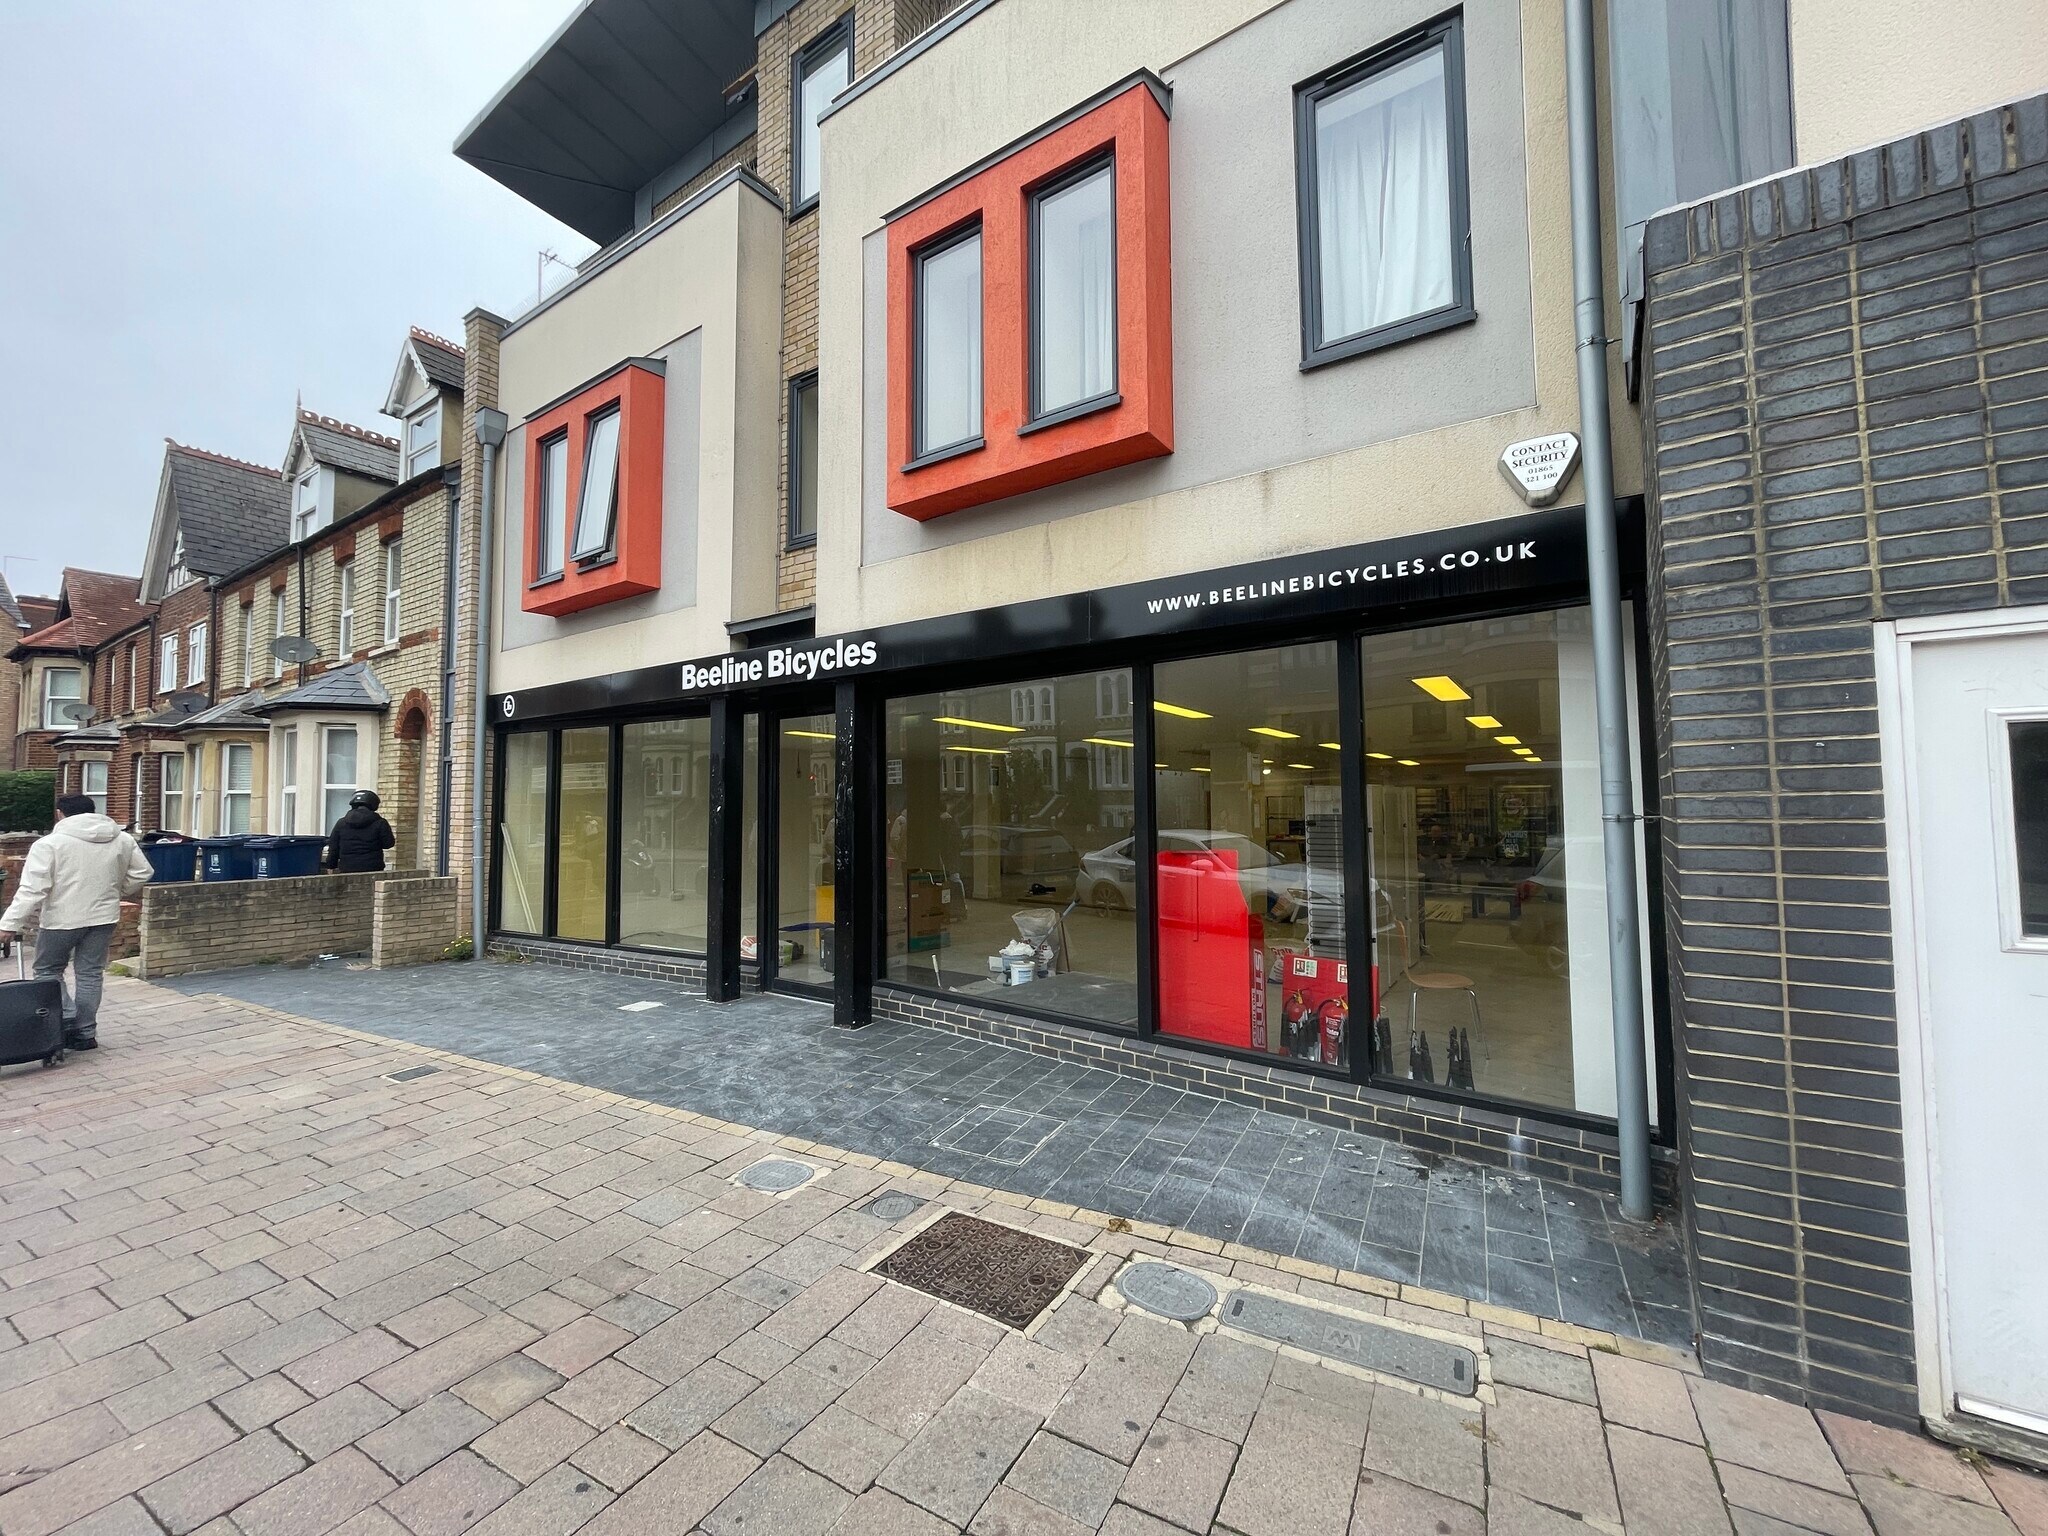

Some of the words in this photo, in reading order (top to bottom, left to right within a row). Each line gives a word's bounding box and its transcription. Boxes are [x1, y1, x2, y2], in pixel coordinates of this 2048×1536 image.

[1511, 439, 1568, 457] CONTACT
[1512, 450, 1569, 468] SECURITY
[1525, 475, 1540, 483] 321
[1543, 472, 1558, 480] 100
[1528, 465, 1554, 475] 01865
[1146, 540, 1537, 614] WWW.BEELINEBICYCLES.CO.UK
[681, 656, 763, 690] Beeline
[767, 638, 878, 681] Bicycles
[1254, 949, 1265, 1047] STANS
